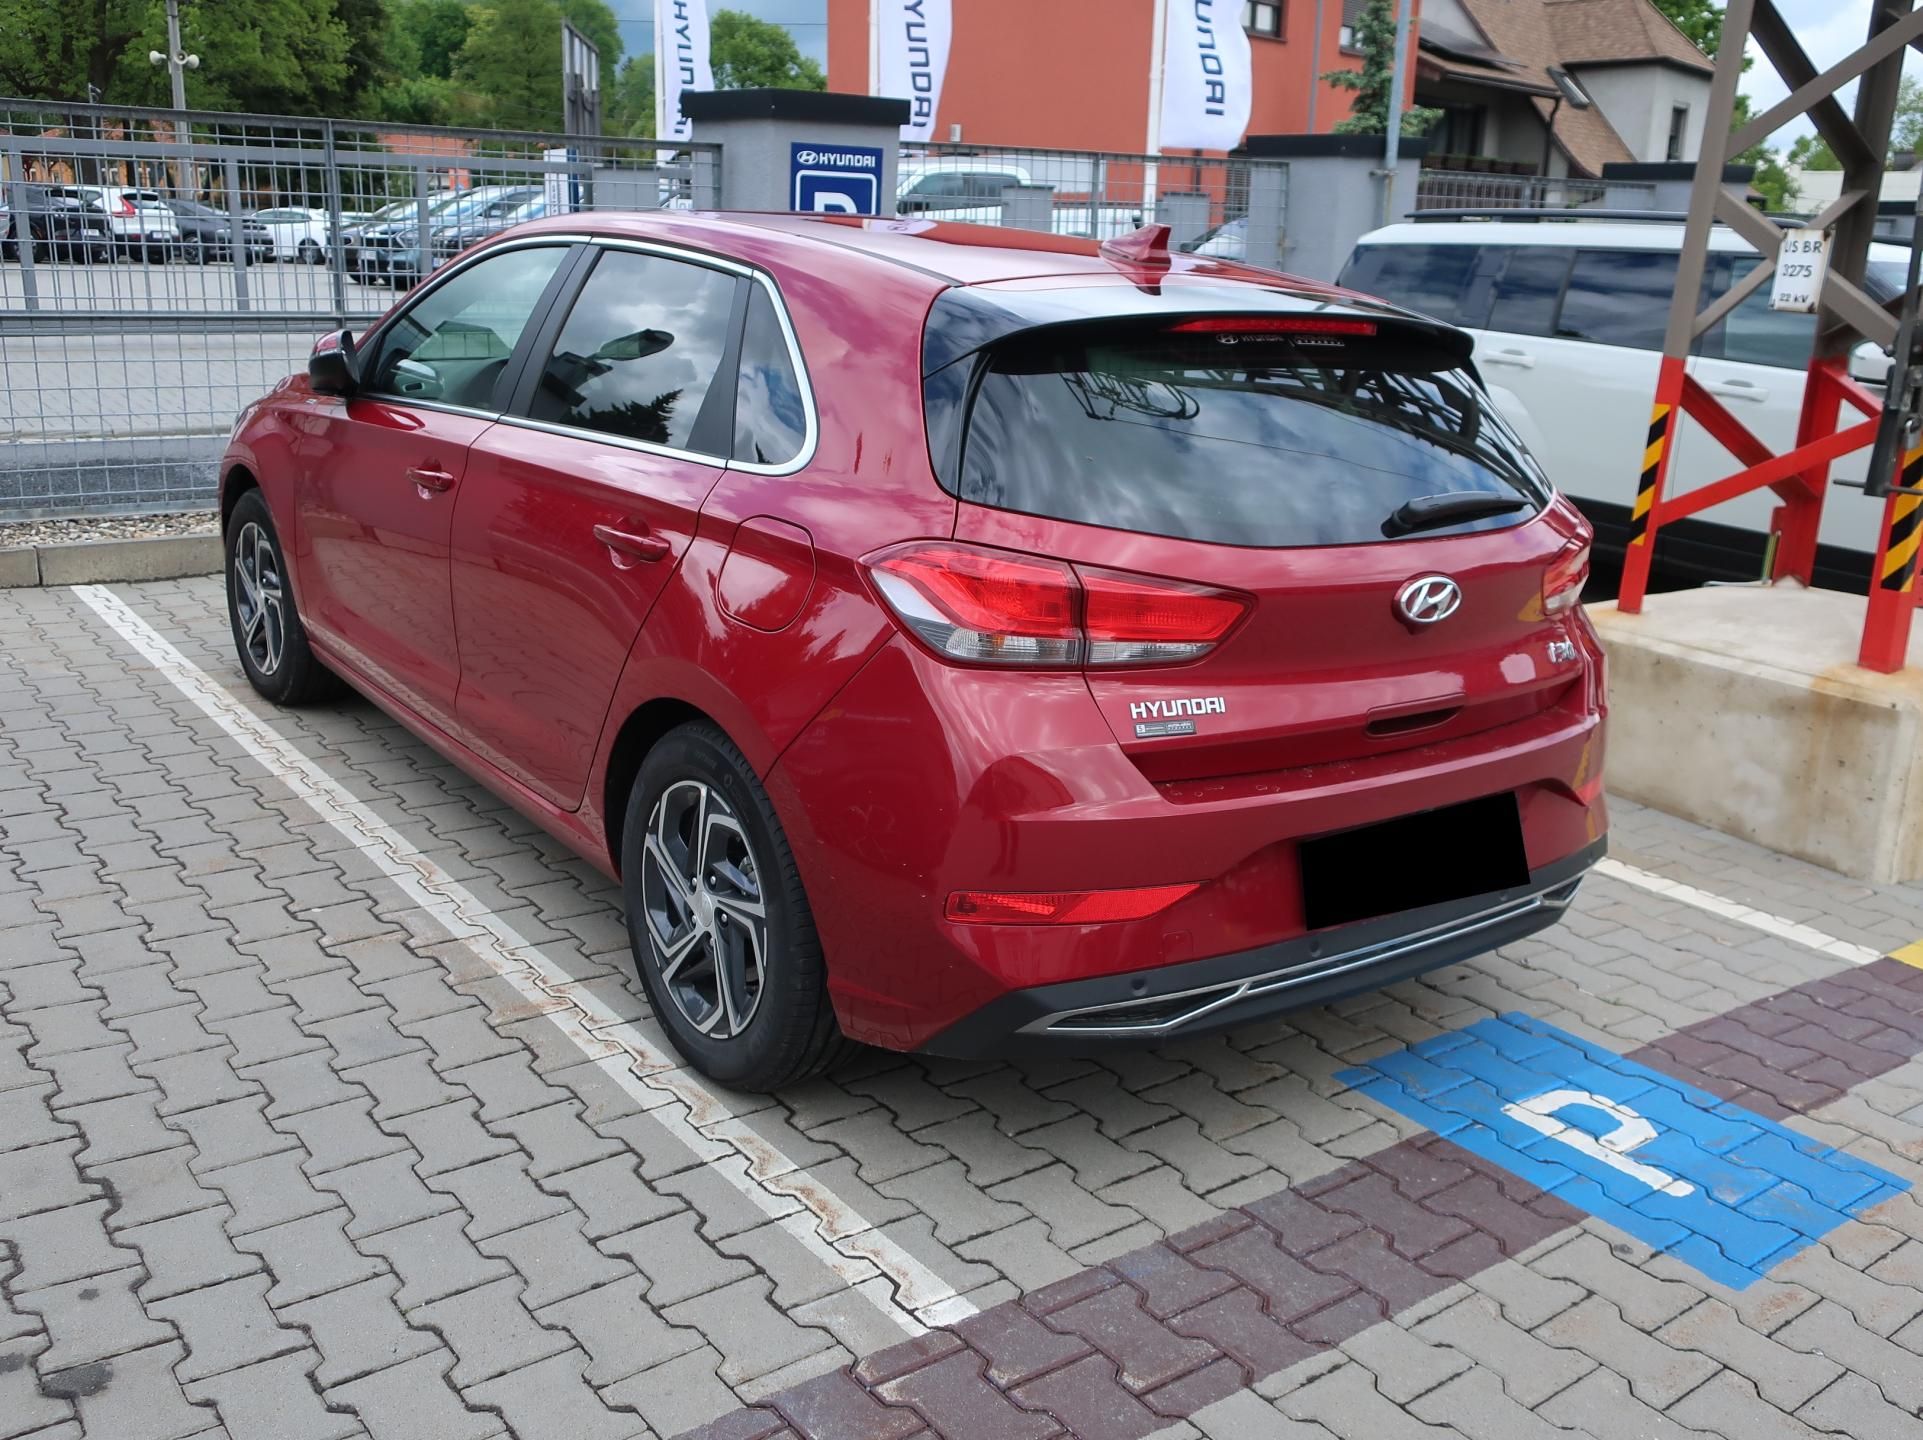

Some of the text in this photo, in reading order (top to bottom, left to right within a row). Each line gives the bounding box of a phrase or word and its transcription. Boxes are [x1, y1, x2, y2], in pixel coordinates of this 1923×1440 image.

[819, 152, 876, 168] HYUNDAI
[1803, 240, 1823, 253] BR
[1782, 263, 1813, 278] 3275
[1129, 696, 1226, 719] HYUNDAI
[1502, 1089, 1694, 1198] P
